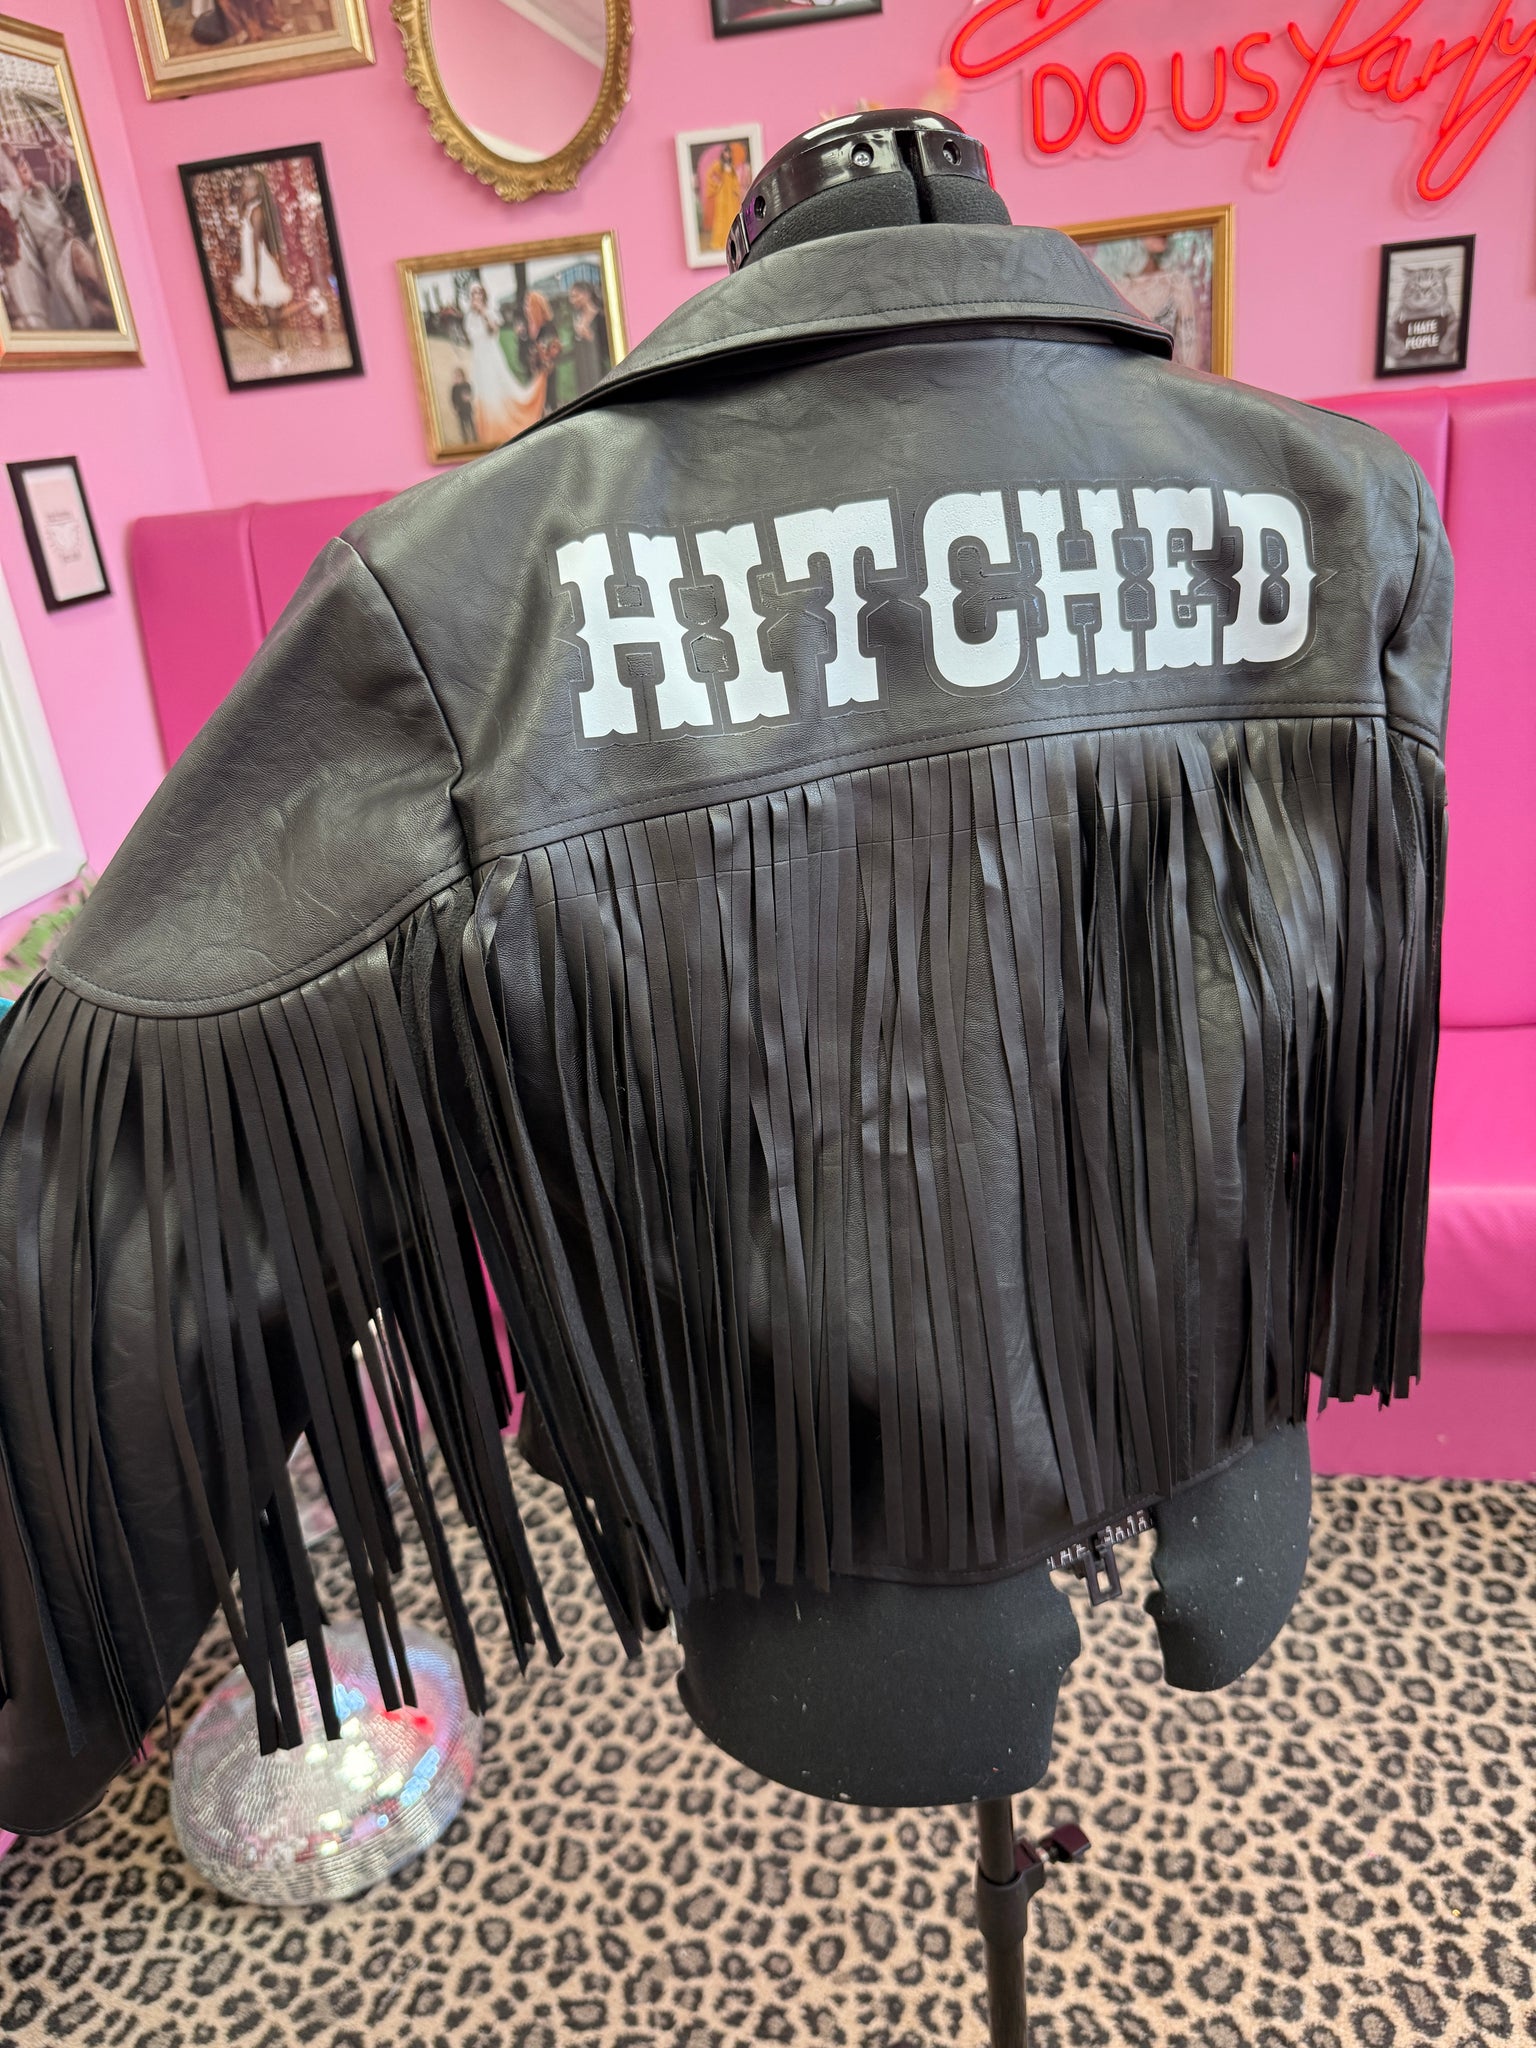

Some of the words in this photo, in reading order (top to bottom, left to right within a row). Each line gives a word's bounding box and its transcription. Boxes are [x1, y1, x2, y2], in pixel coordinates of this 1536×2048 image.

[1032, 52, 1146, 154] DO
[1171, 32, 1280, 133] US
[1405, 333, 1440, 350] PEOPLE
[1413, 319, 1438, 334] HATE
[555, 488, 1318, 739] HITCHED
